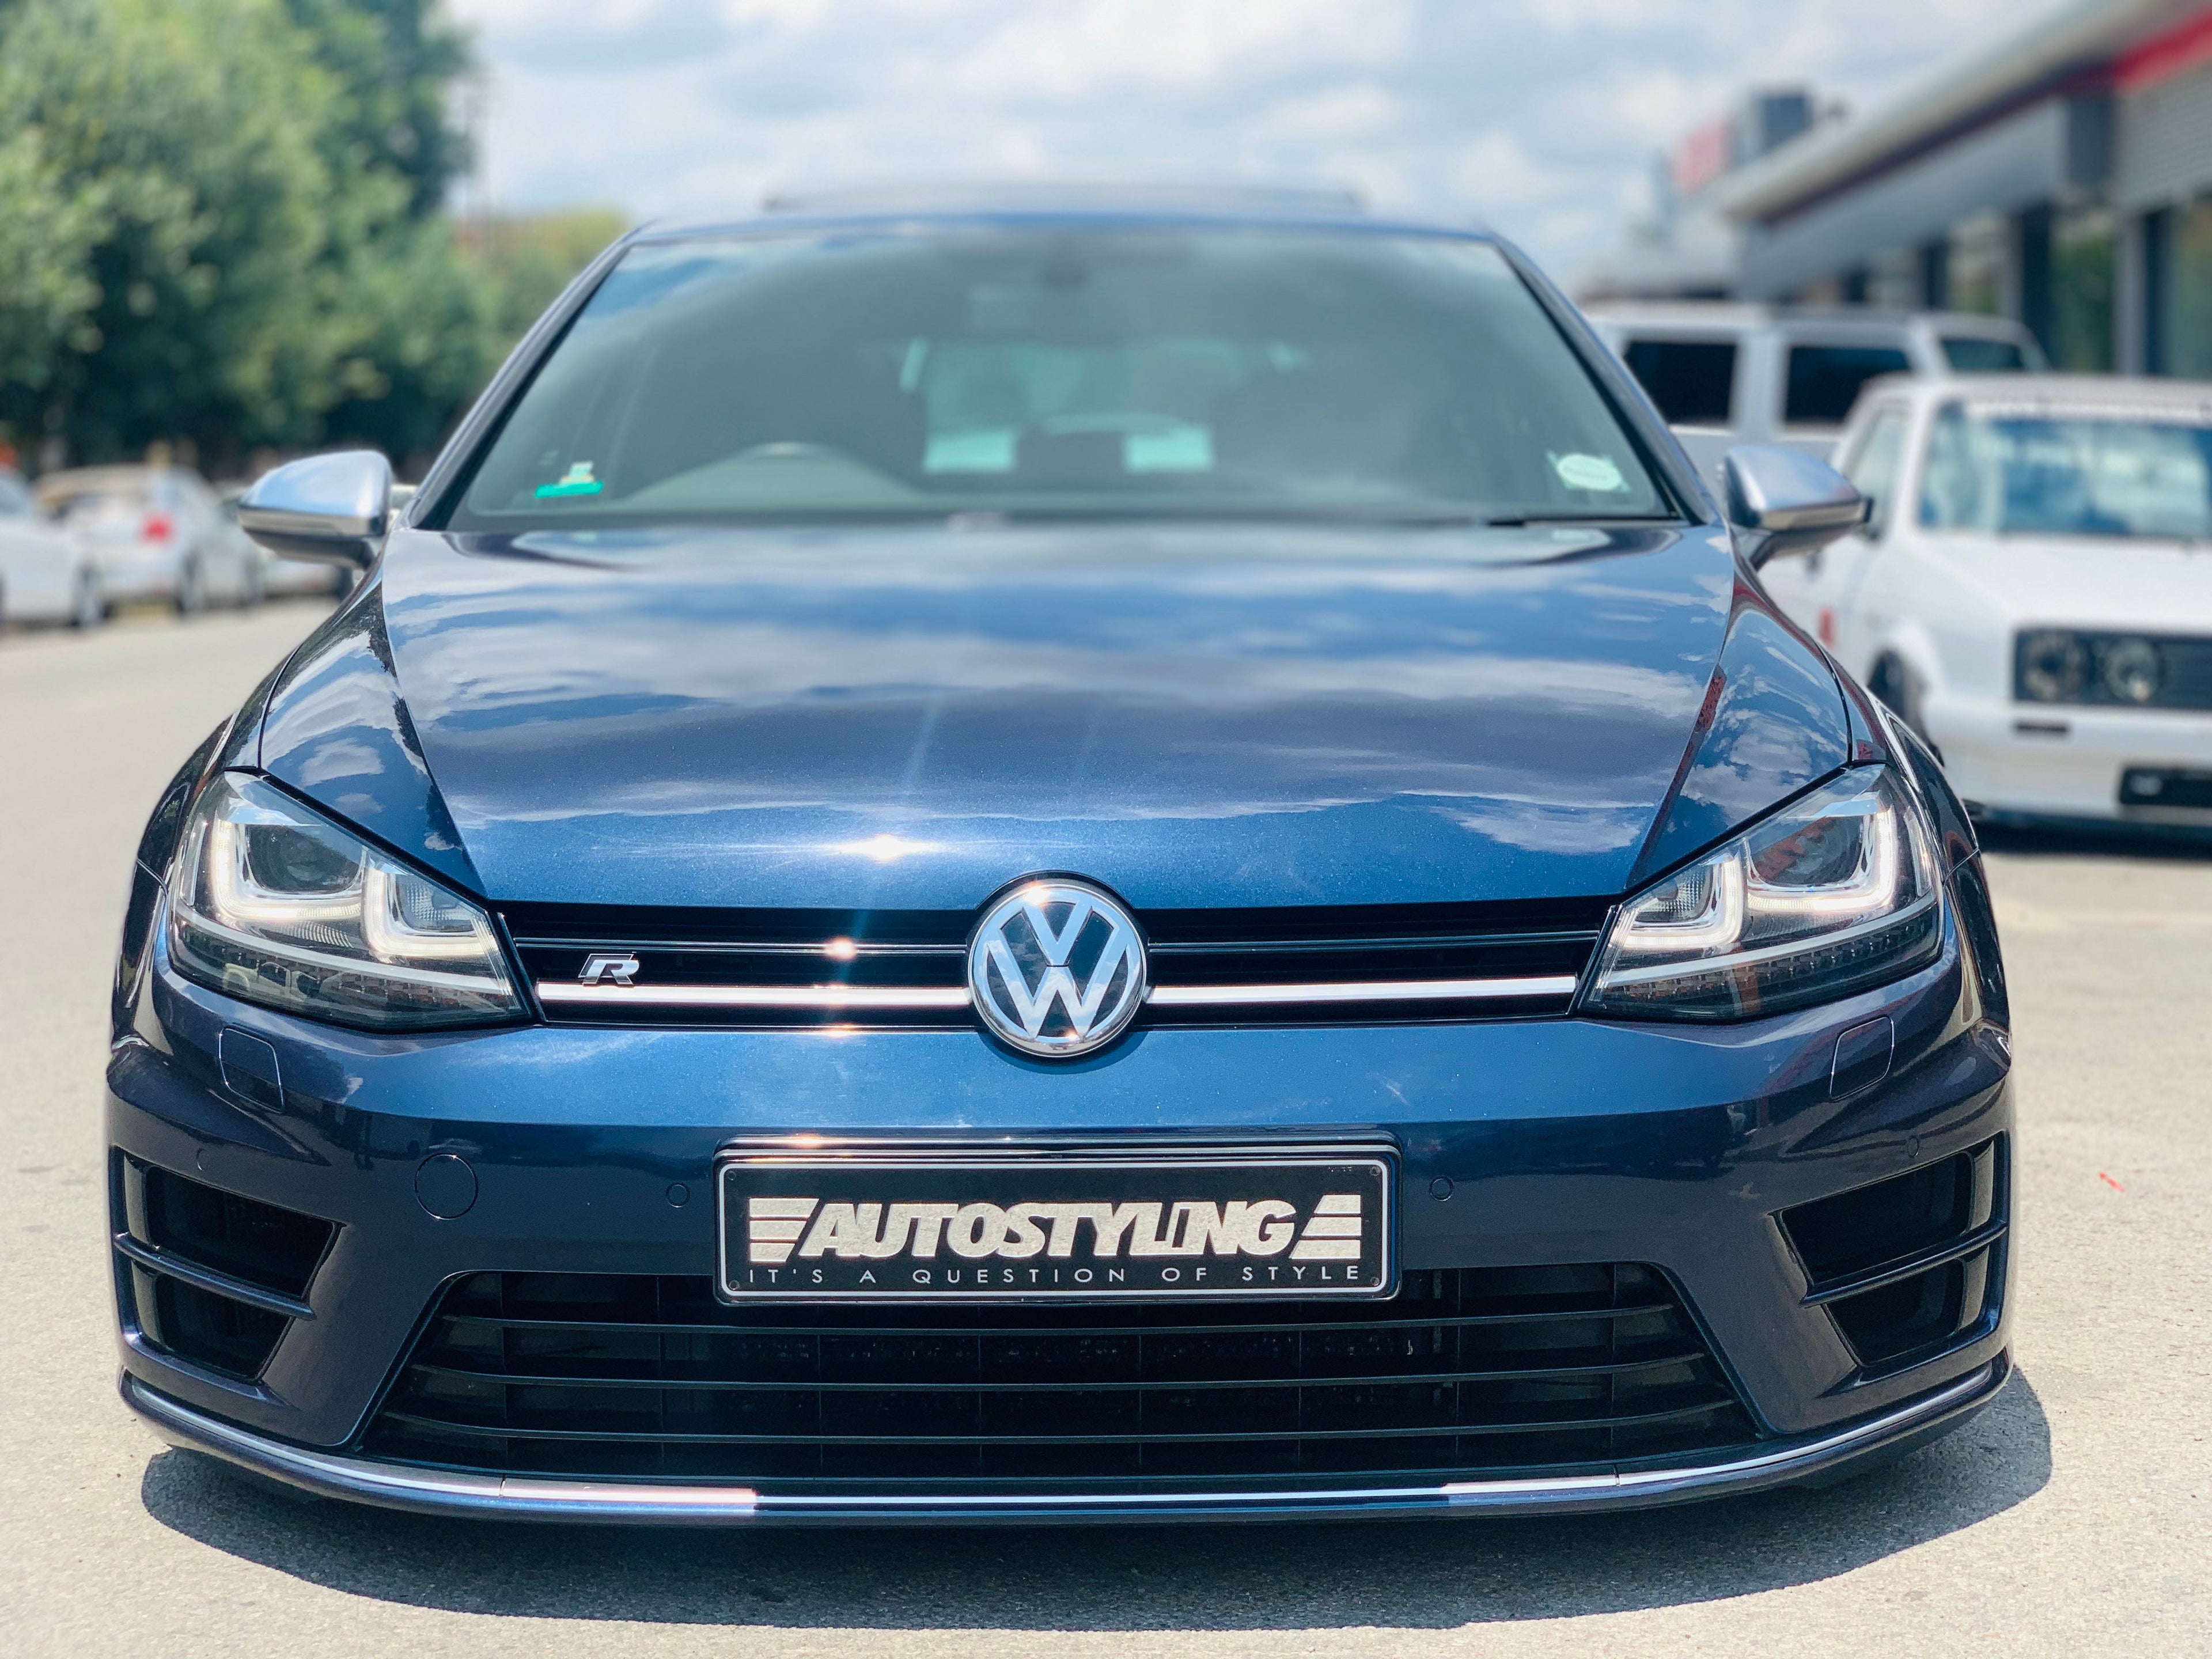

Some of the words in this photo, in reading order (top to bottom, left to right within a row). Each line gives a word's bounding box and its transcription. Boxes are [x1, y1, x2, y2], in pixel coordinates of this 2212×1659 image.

[578, 953, 639, 984] R
[750, 1269, 823, 1283] IT'S
[859, 1269, 876, 1283] A
[912, 1268, 1124, 1284] QUESTION
[1161, 1267, 1207, 1282] OF
[1243, 1266, 1358, 1282] STYLE
